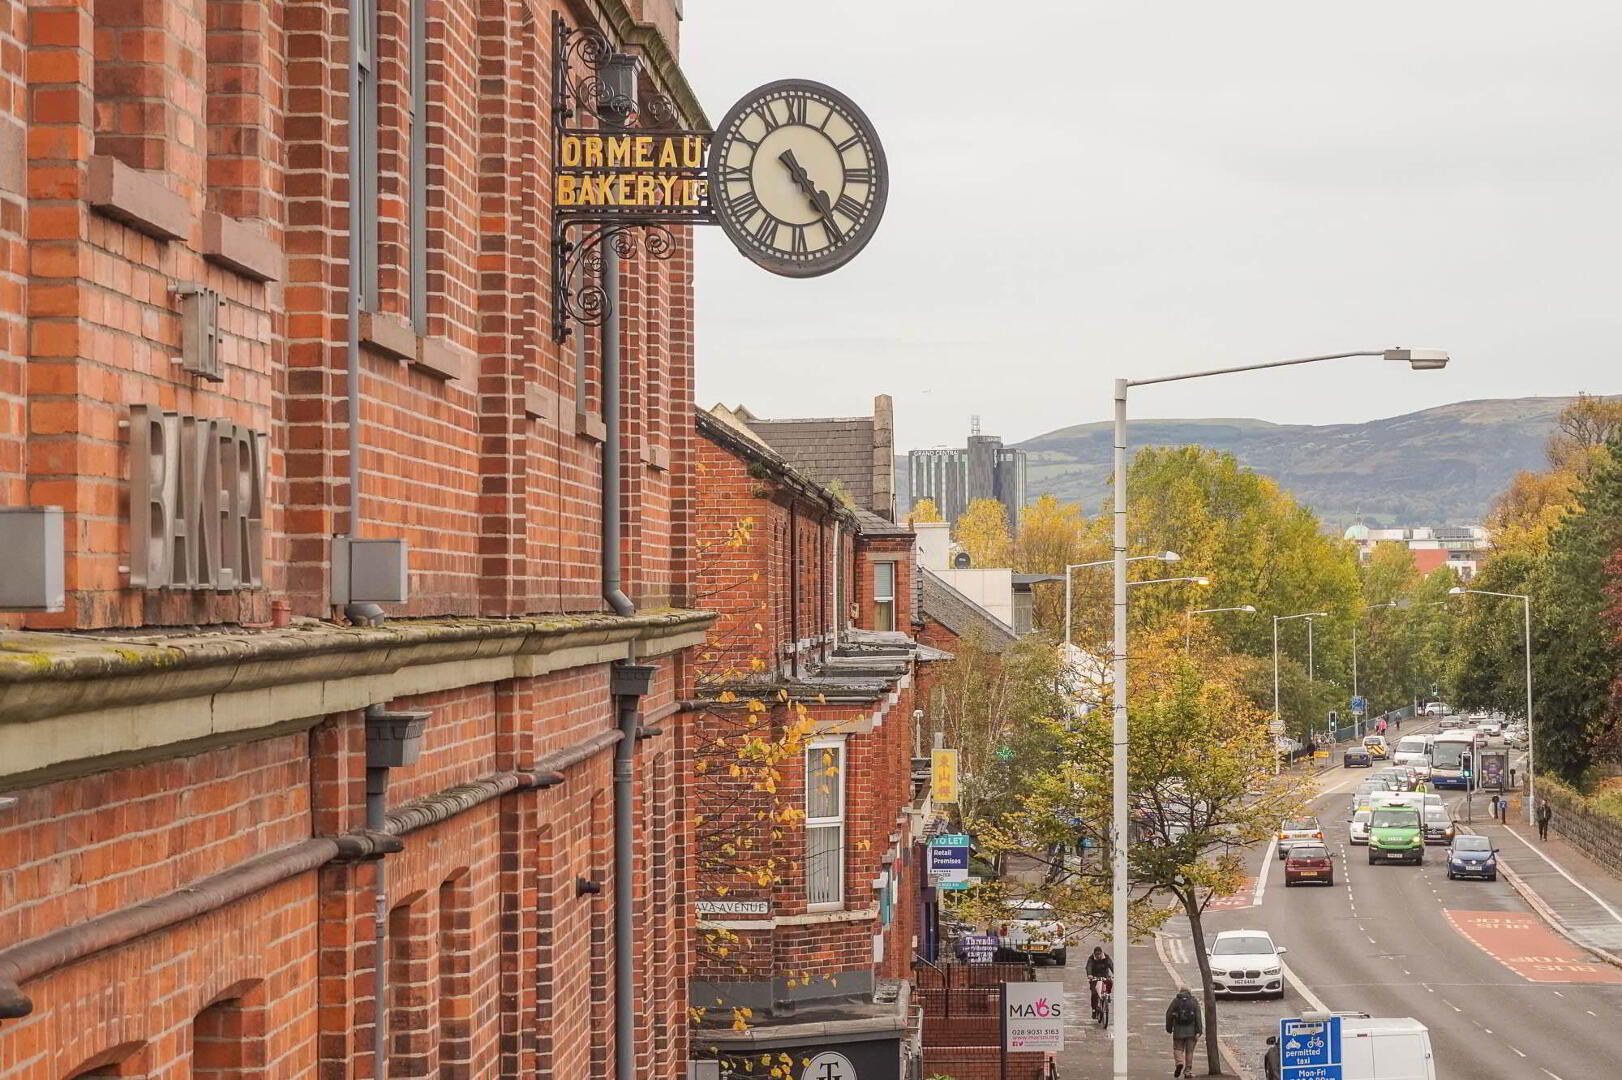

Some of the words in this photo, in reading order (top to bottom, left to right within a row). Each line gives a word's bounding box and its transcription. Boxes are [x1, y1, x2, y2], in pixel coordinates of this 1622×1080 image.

[563, 136, 701, 168] ORMEAU
[558, 175, 678, 206] BAKERY
[948, 836, 964, 845] LET
[720, 903, 765, 912] AVENUE
[1285, 1049, 1320, 1058] permitted
[1298, 1068, 1327, 1077] Mon-Fri
